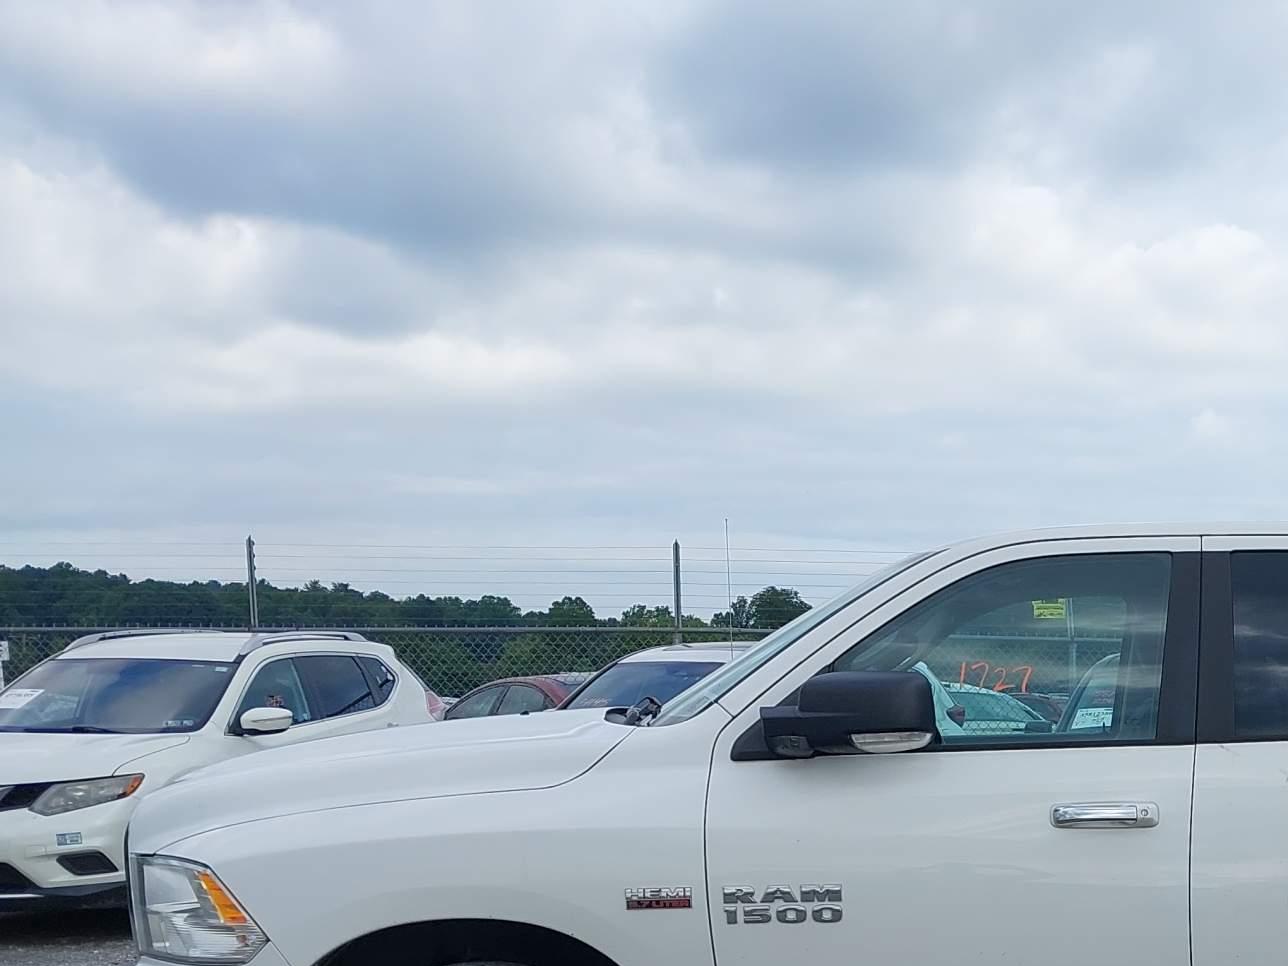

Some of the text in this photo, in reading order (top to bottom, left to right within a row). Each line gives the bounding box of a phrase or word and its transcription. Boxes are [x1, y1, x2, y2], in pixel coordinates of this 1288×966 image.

[959, 661, 1033, 693] 1727
[625, 887, 692, 899] HEMI
[722, 884, 842, 904] RAM
[723, 904, 843, 925] 1500
